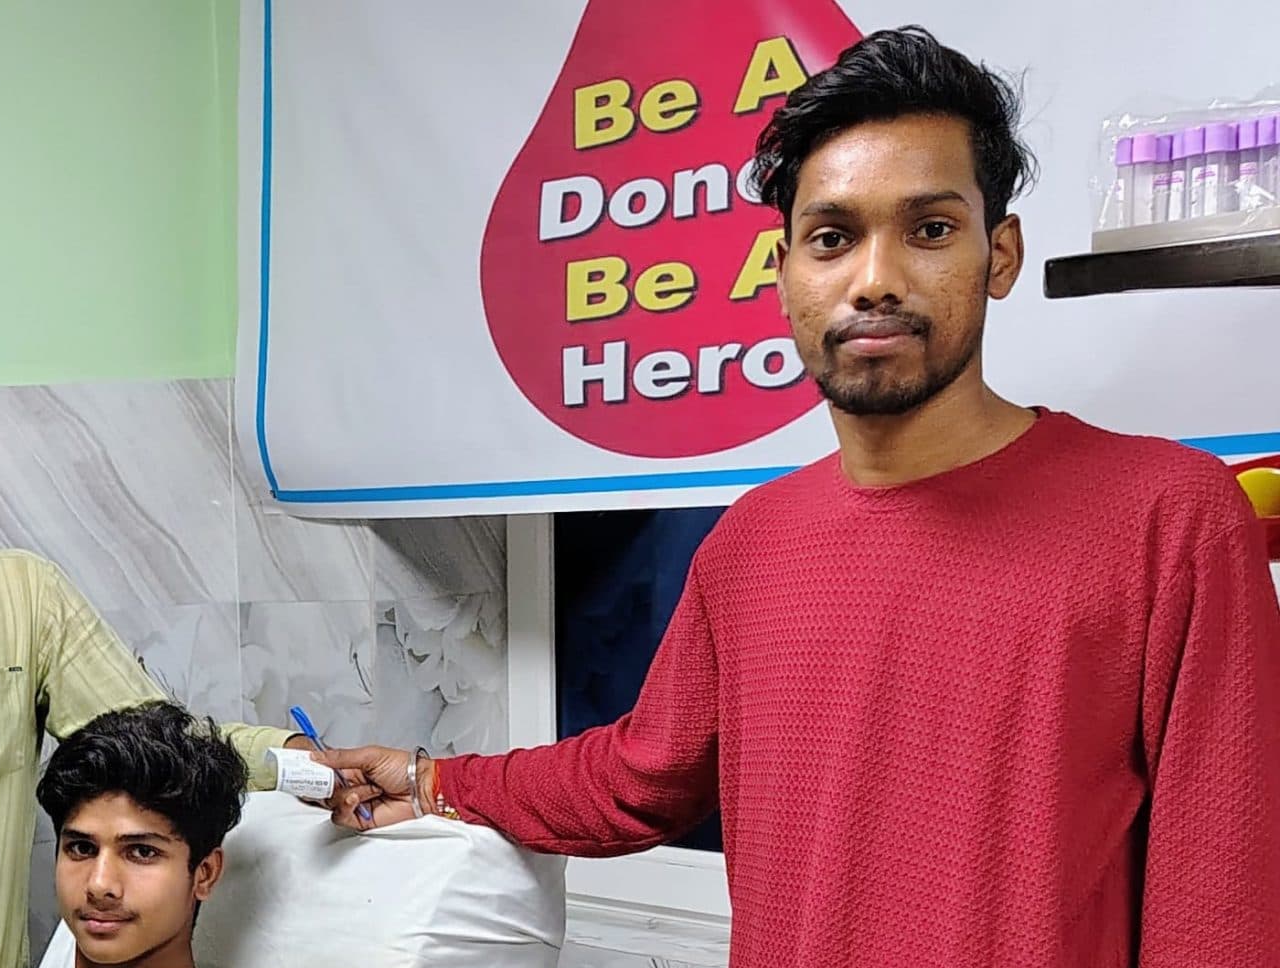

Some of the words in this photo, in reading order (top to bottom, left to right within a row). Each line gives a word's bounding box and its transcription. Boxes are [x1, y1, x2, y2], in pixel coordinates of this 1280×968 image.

[574, 79, 698, 150] Be
[733, 36, 808, 113] A
[566, 256, 696, 322] Be
[729, 228, 785, 299] A
[562, 336, 805, 406] Hero
